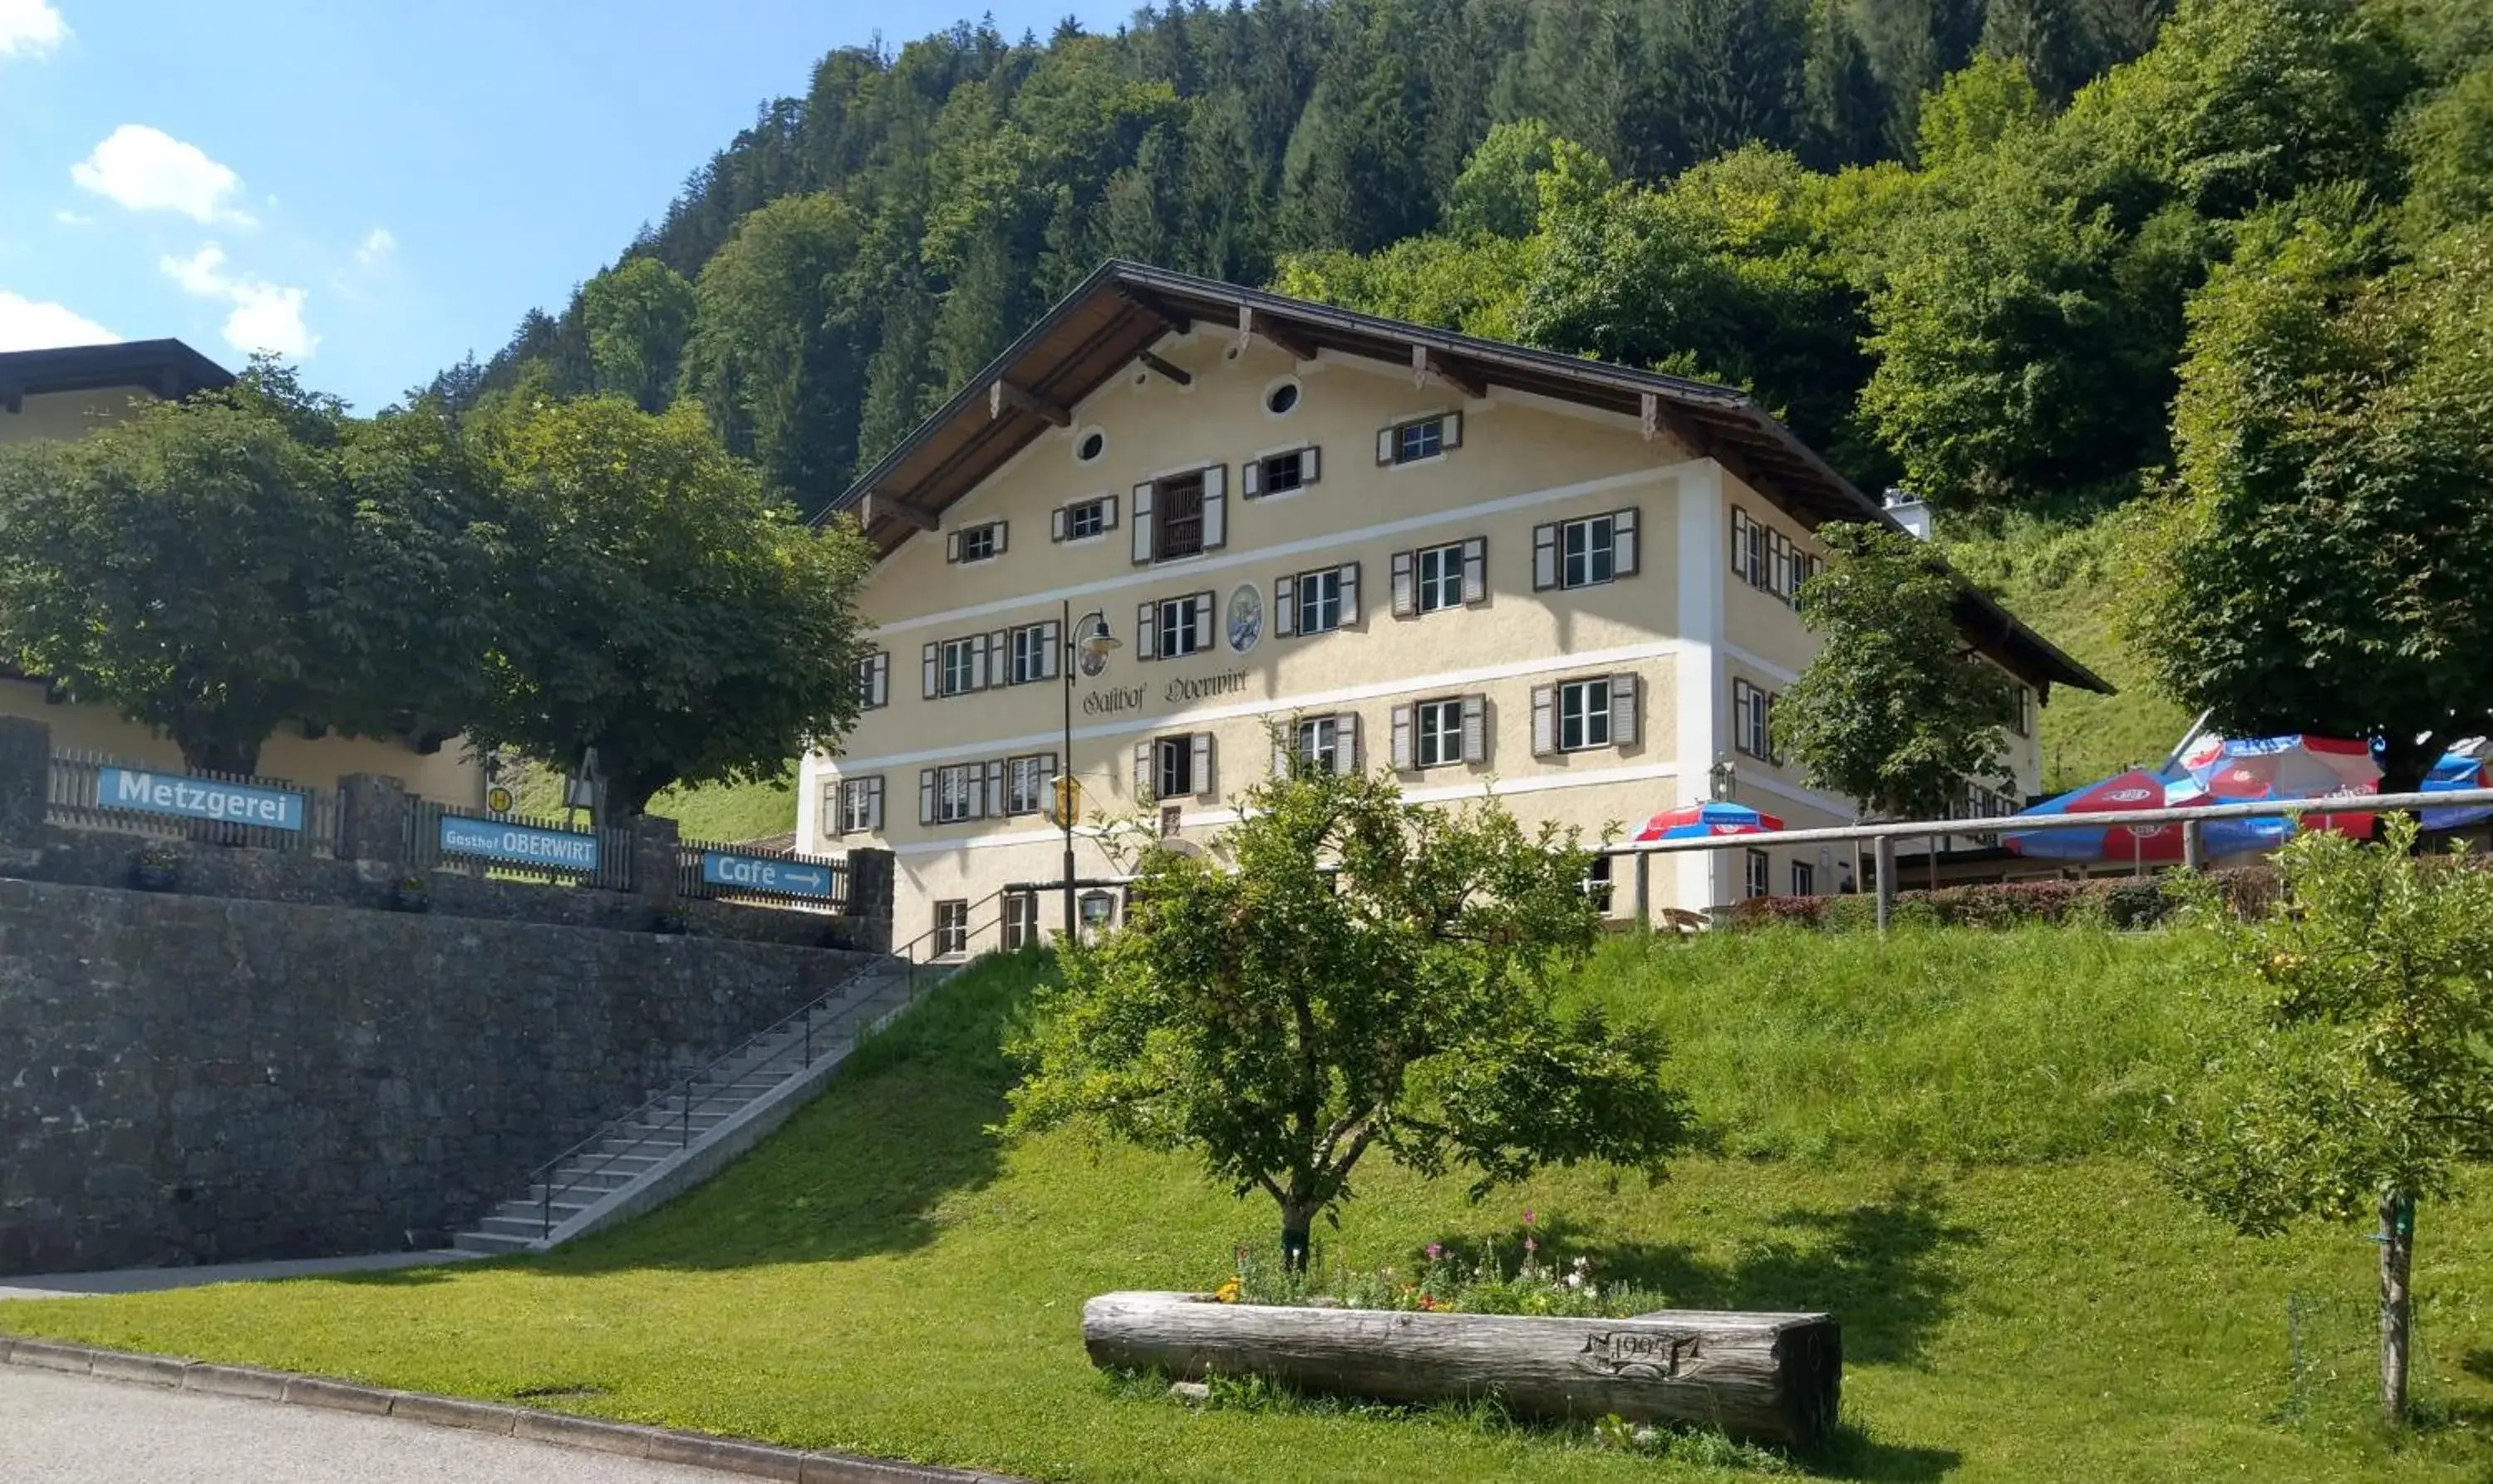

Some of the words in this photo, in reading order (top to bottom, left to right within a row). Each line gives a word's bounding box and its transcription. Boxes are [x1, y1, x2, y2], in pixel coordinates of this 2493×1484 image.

[1164, 667, 1248, 703] Oberwirt
[118, 770, 287, 821] Metzgerei
[446, 830, 499, 849] Gasthof
[503, 832, 594, 862] OBERWIRT
[718, 857, 775, 885] Café
